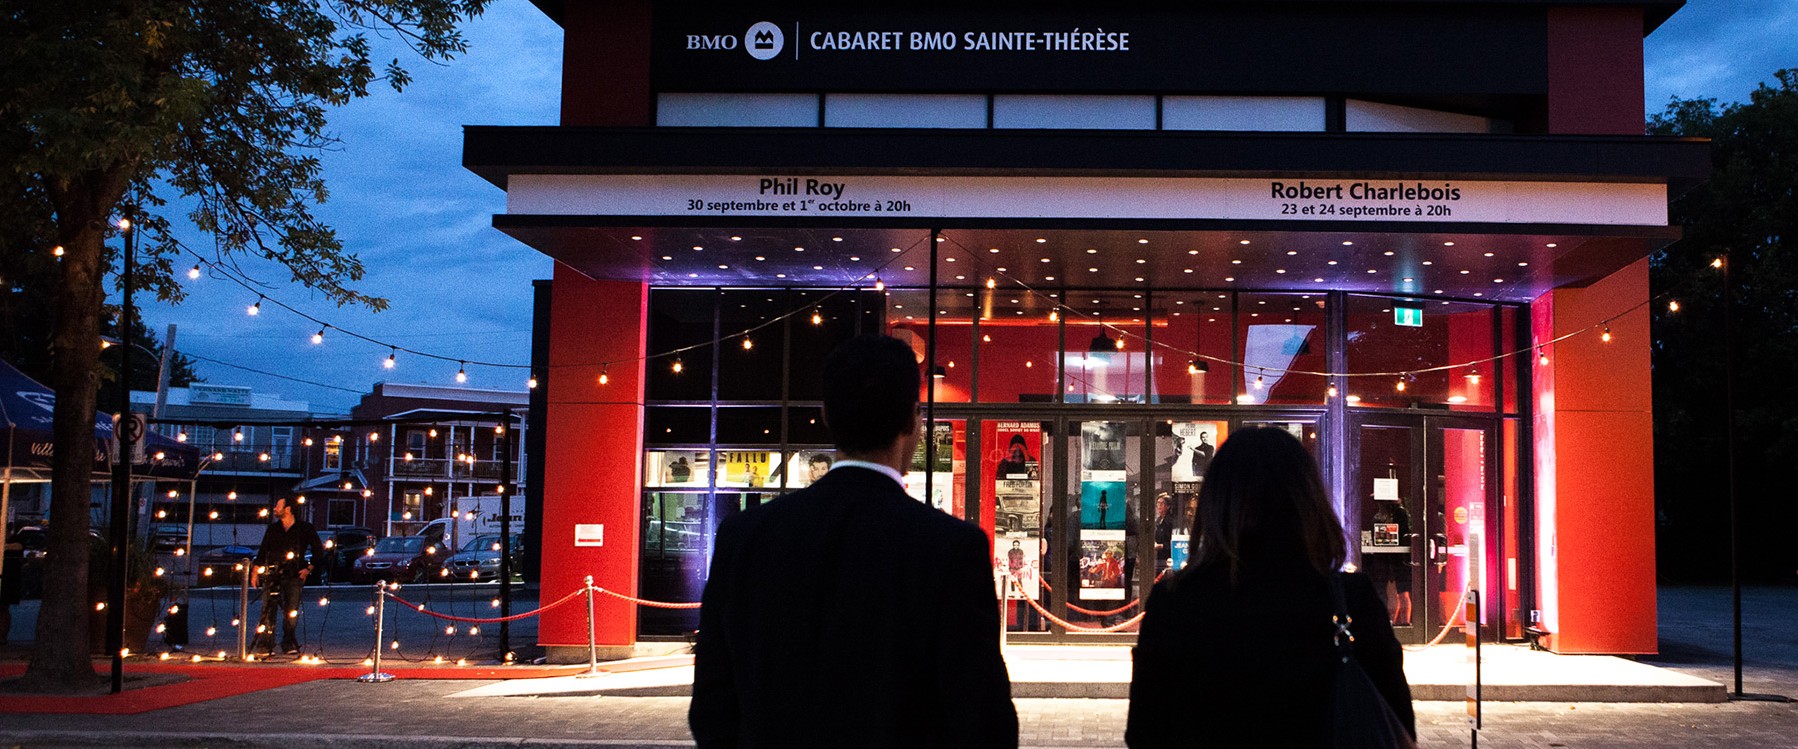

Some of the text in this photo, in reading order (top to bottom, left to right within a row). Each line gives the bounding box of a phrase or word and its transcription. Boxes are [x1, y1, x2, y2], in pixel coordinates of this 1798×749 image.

[687, 34, 737, 50] BMO
[810, 28, 1130, 51] CABARET BMO SAINTE-THÉRÈSE
[760, 178, 845, 200] Phil Roy
[1271, 182, 1461, 200] Robert Charlebois
[687, 199, 703, 211] 30
[707, 200, 778, 214] septembre
[782, 201, 796, 211] et
[818, 200, 870, 212] octobre
[874, 200, 882, 212] à
[886, 201, 911, 212] 20h
[1281, 203, 1451, 218] 23 et 24 septembre à 20h
[31, 442, 54, 457] Vill
